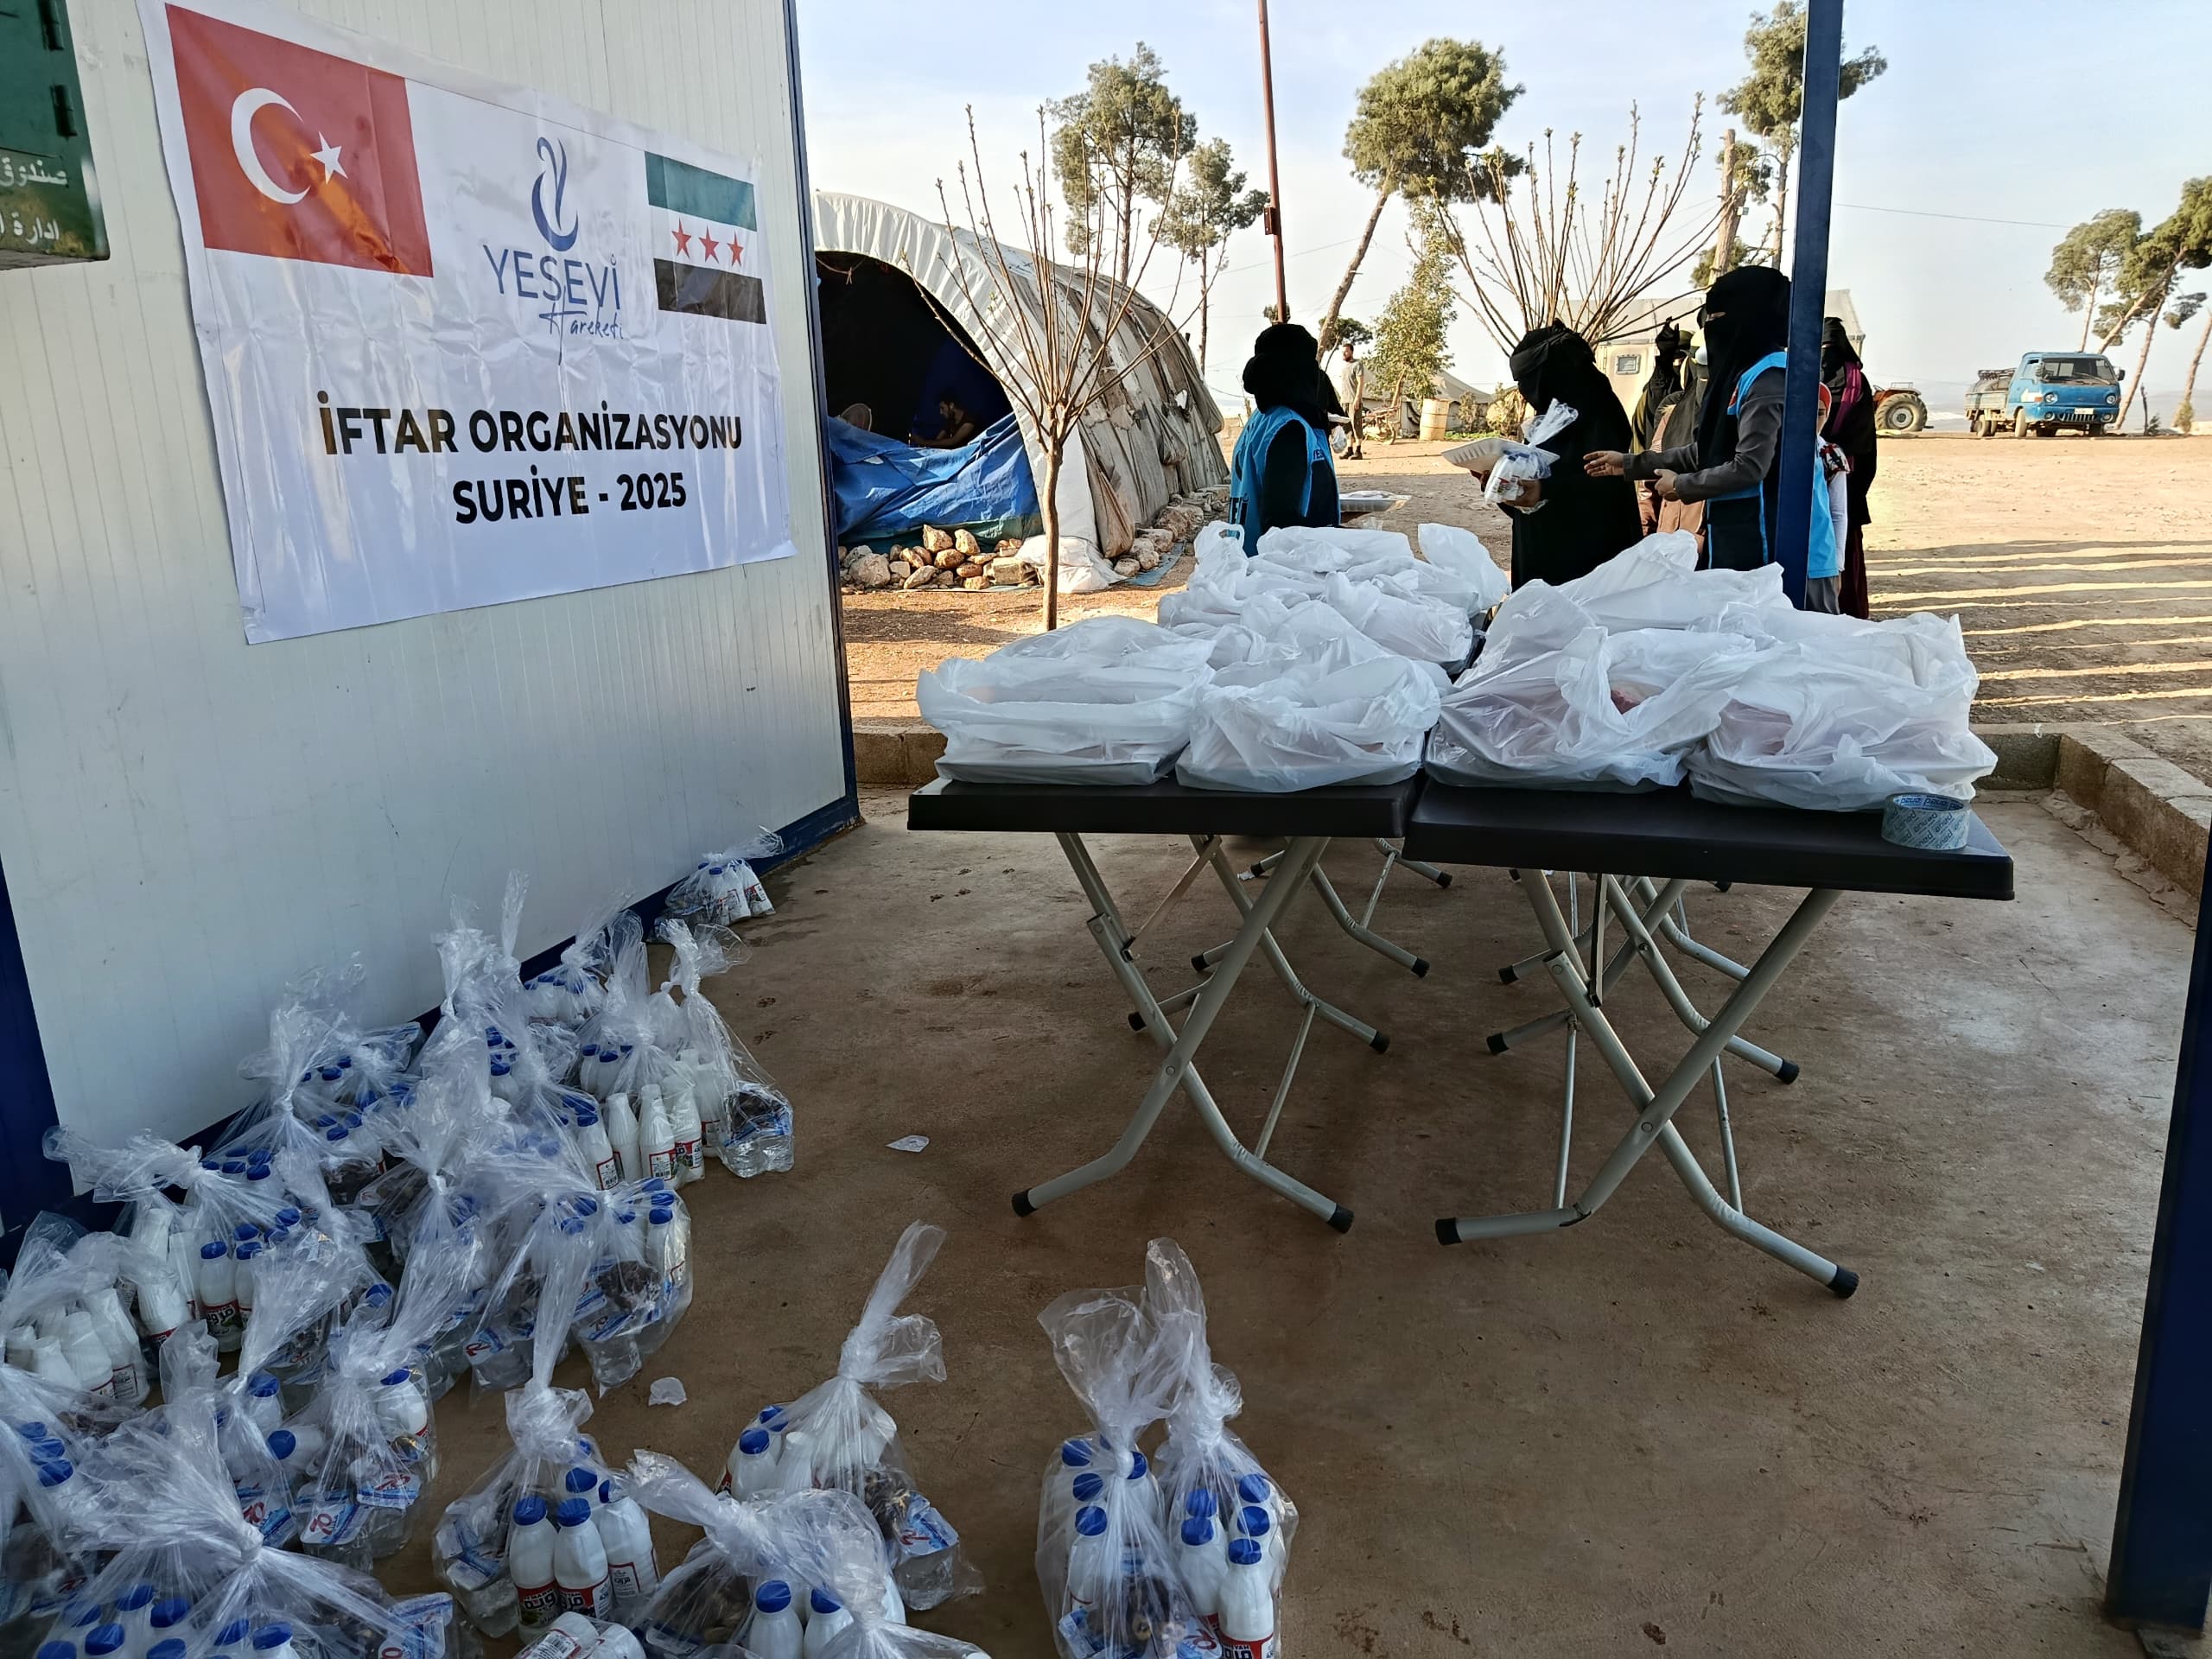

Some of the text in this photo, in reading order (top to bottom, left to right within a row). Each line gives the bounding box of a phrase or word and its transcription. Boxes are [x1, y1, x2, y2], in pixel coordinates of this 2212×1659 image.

[317, 390, 743, 456] İFTAR ORGANİZASYONU
[453, 464, 590, 524] SURİYE
[617, 472, 687, 512] 2025
